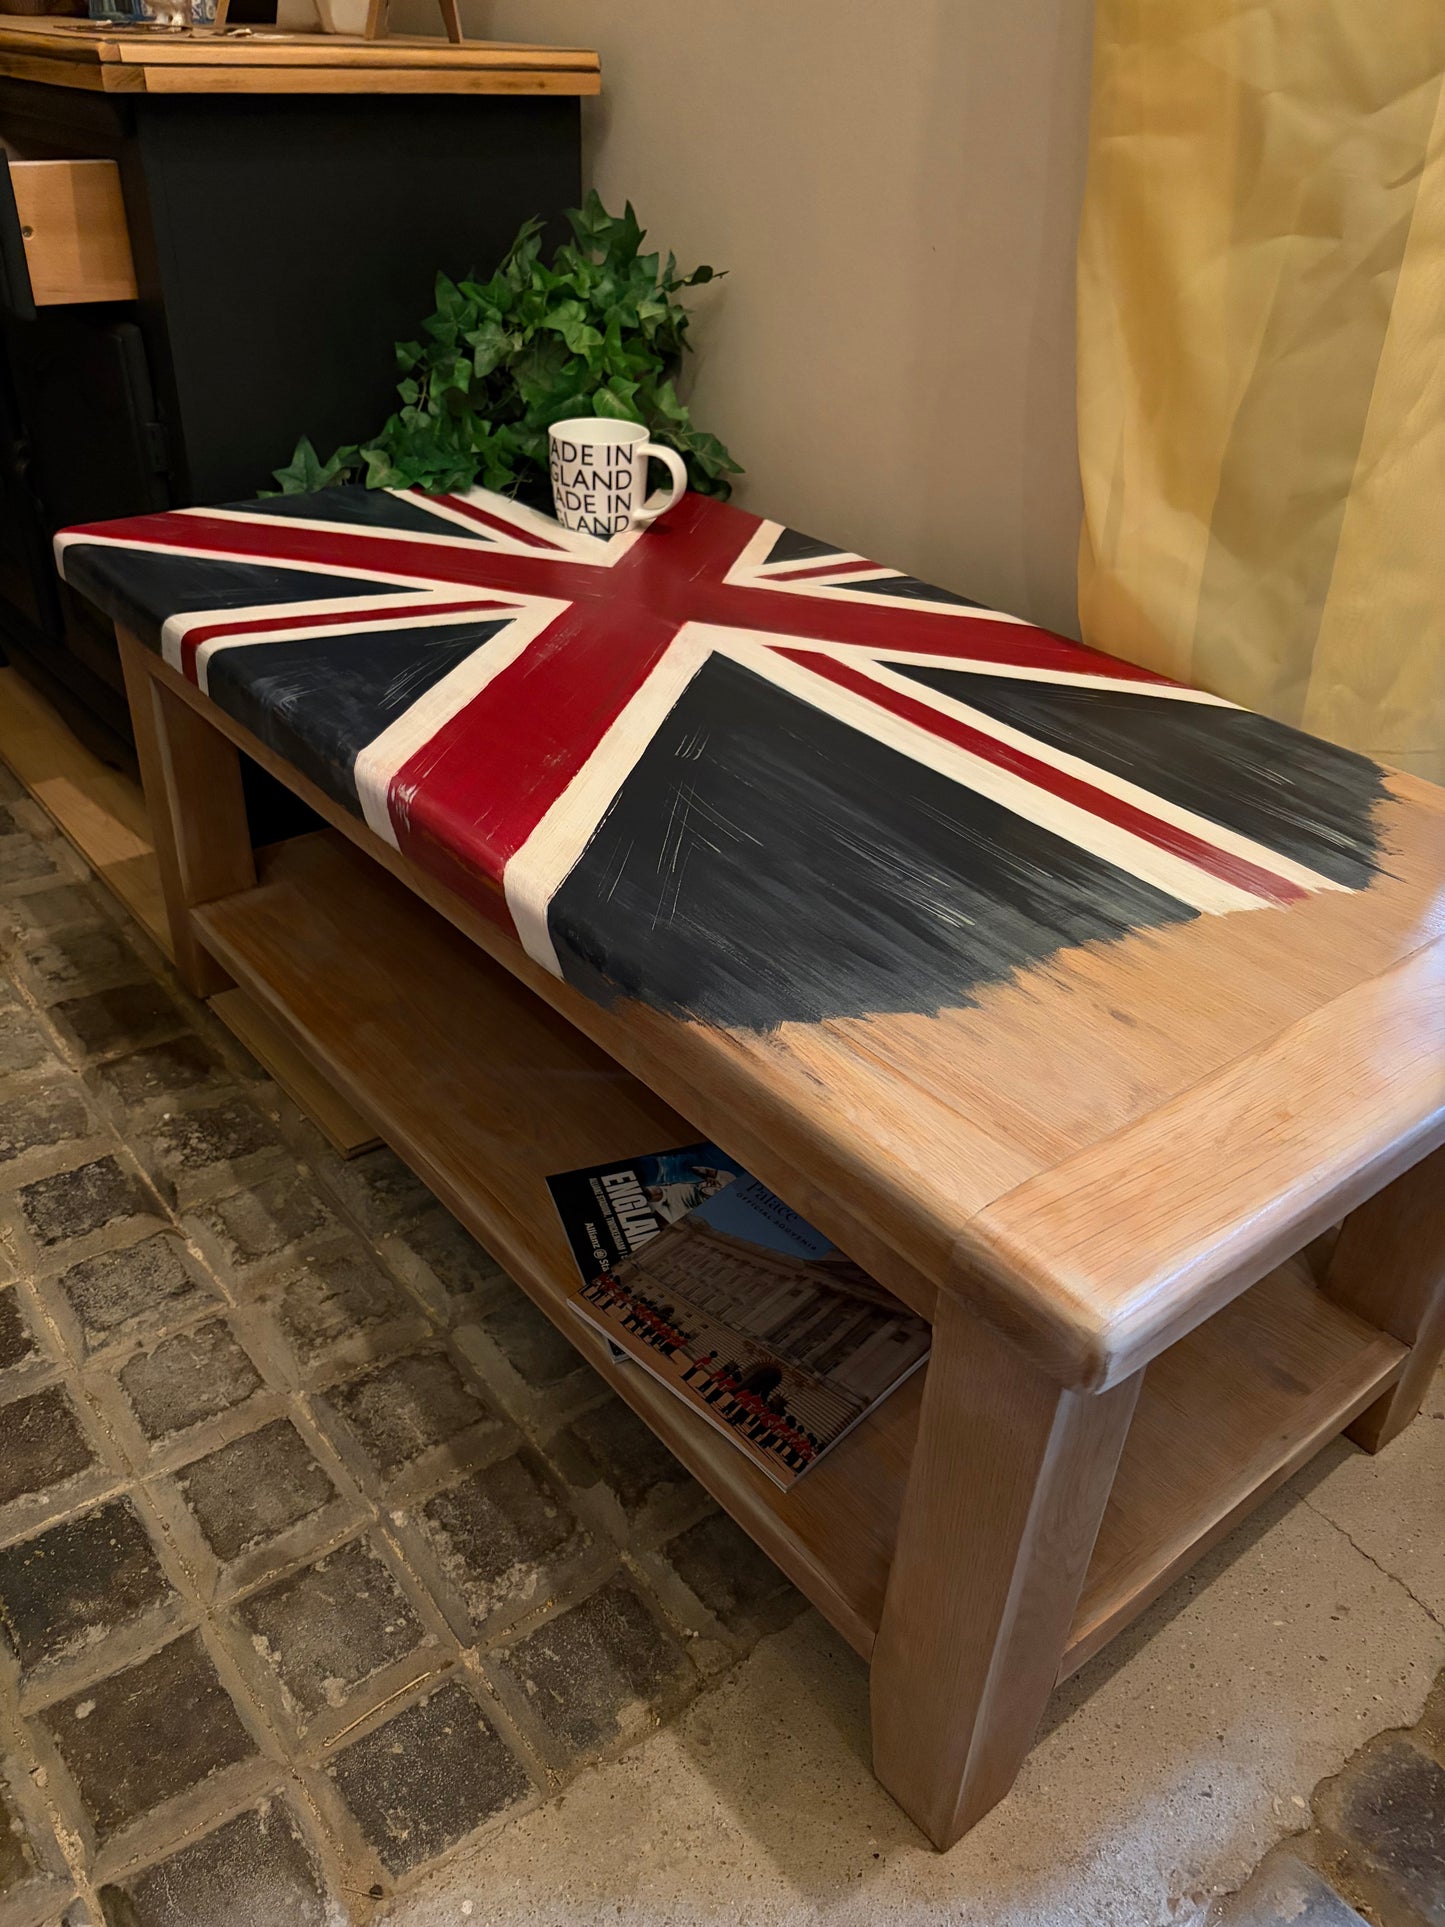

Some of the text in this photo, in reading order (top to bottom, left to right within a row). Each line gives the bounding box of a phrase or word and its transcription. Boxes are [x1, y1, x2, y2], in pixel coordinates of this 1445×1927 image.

[607, 443, 633, 466] IN
[608, 492, 632, 514] IN
[746, 1181, 798, 1223] Palace
[736, 1192, 817, 1251] OFFICIAL SOUVENIR
[584, 1222, 600, 1249] Allianz
